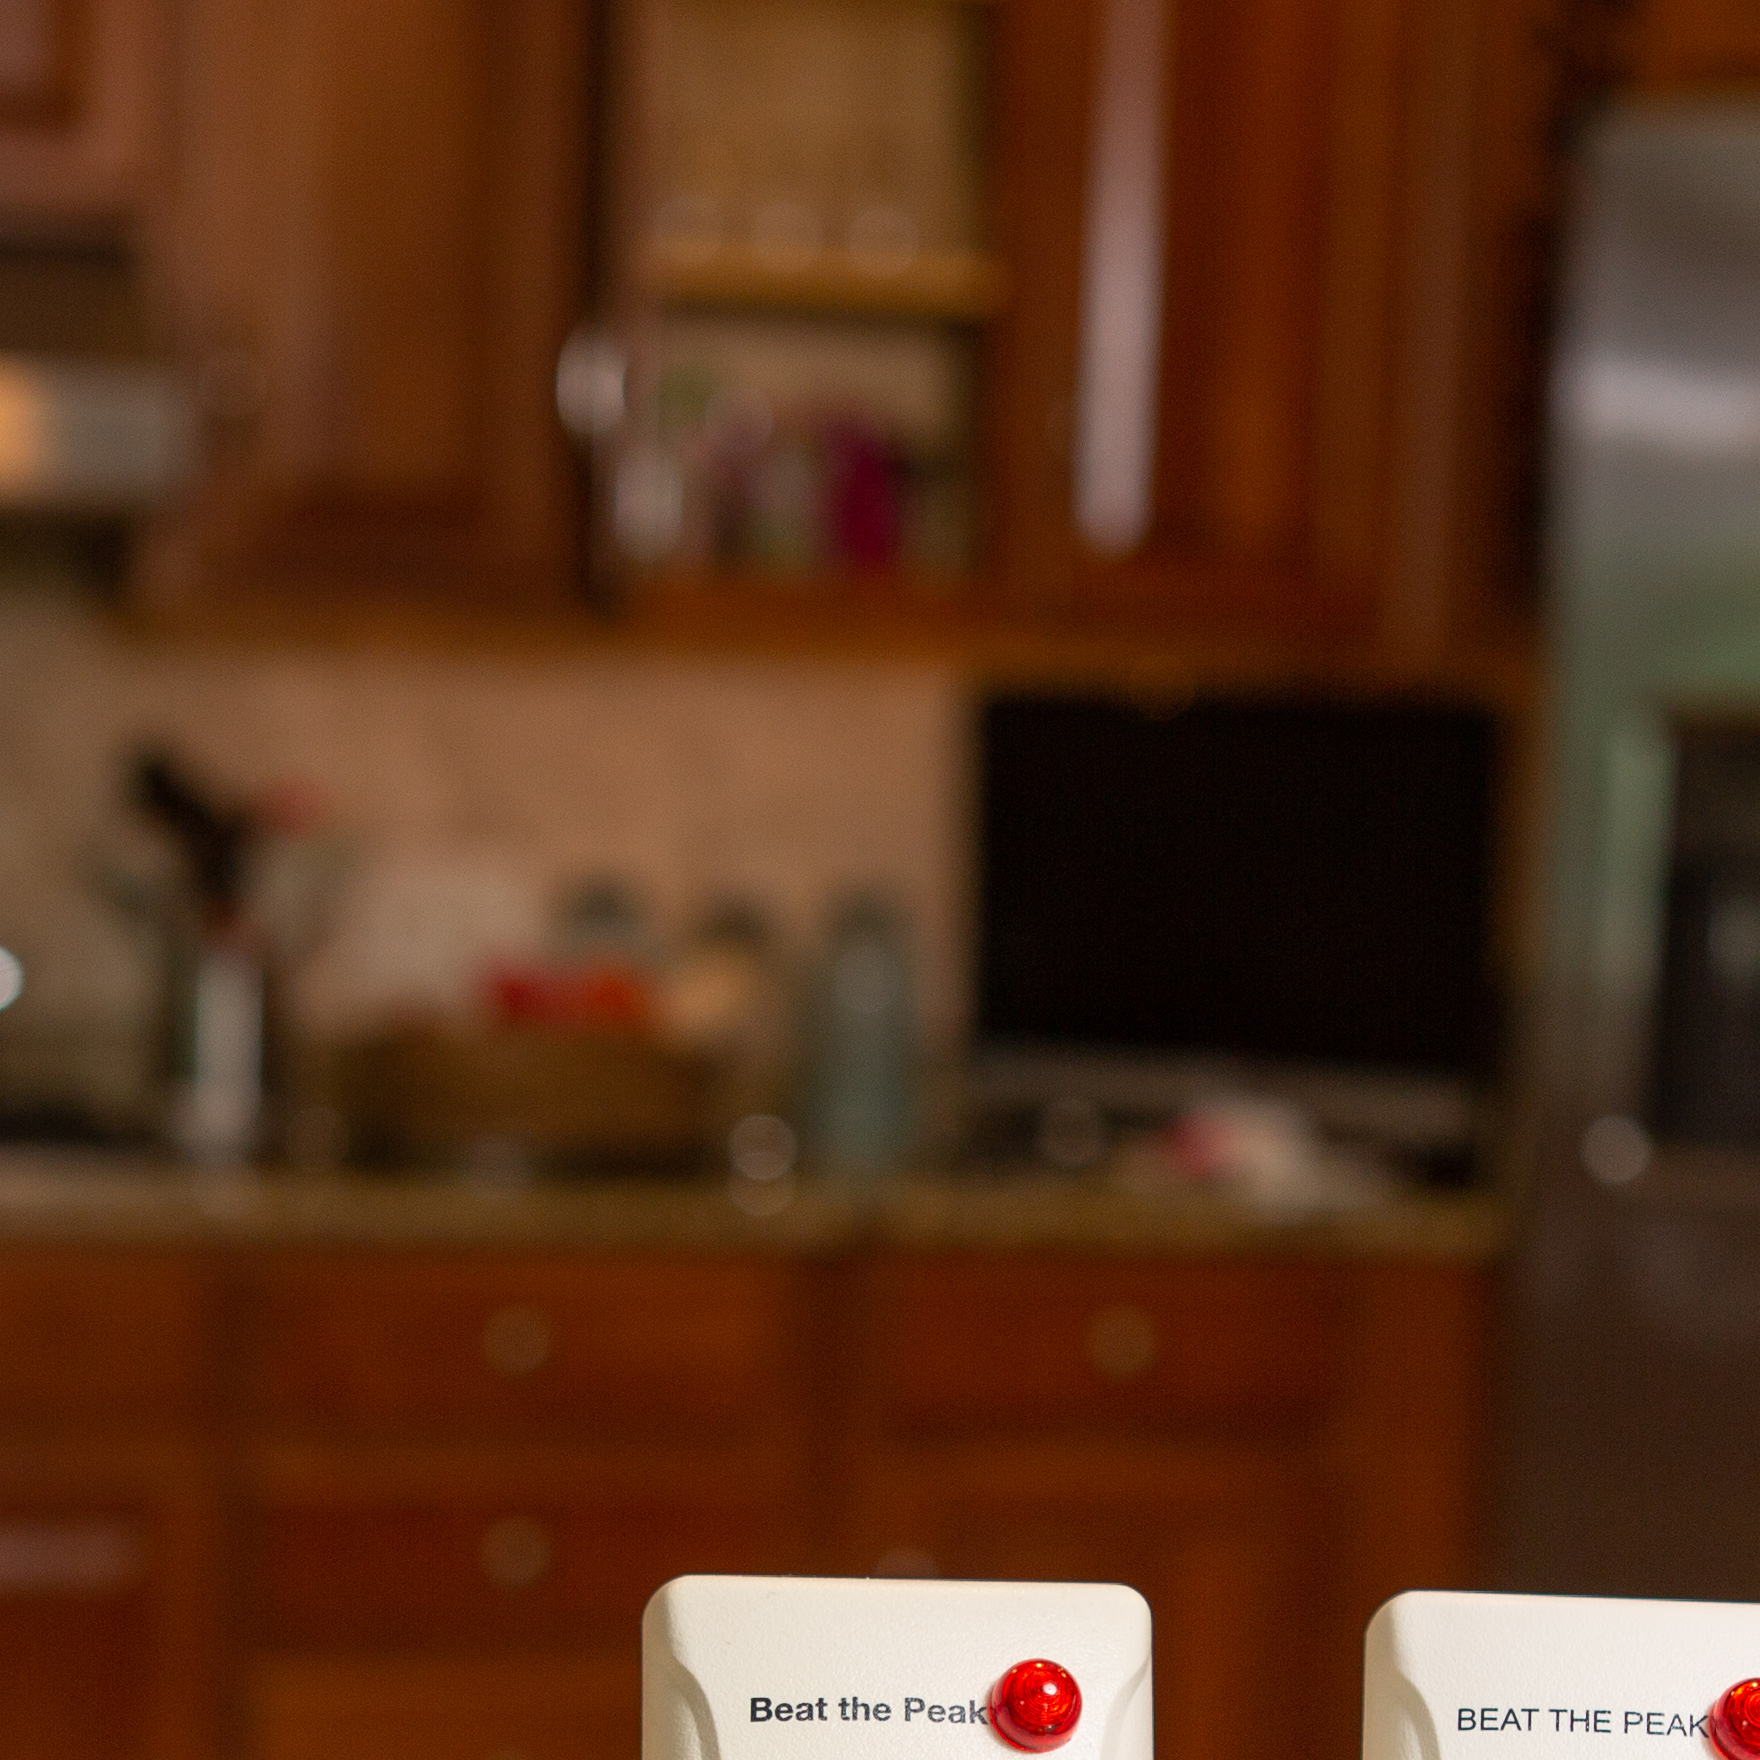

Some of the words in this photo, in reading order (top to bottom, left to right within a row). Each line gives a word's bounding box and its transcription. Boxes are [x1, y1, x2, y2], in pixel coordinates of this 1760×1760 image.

[750, 1697, 828, 1722] Beat
[838, 1697, 891, 1722] the
[904, 1697, 989, 1725] Peak
[1457, 1708, 1539, 1732] BEAT
[1549, 1709, 1611, 1733] THE
[1624, 1711, 1710, 1739] PEAK
